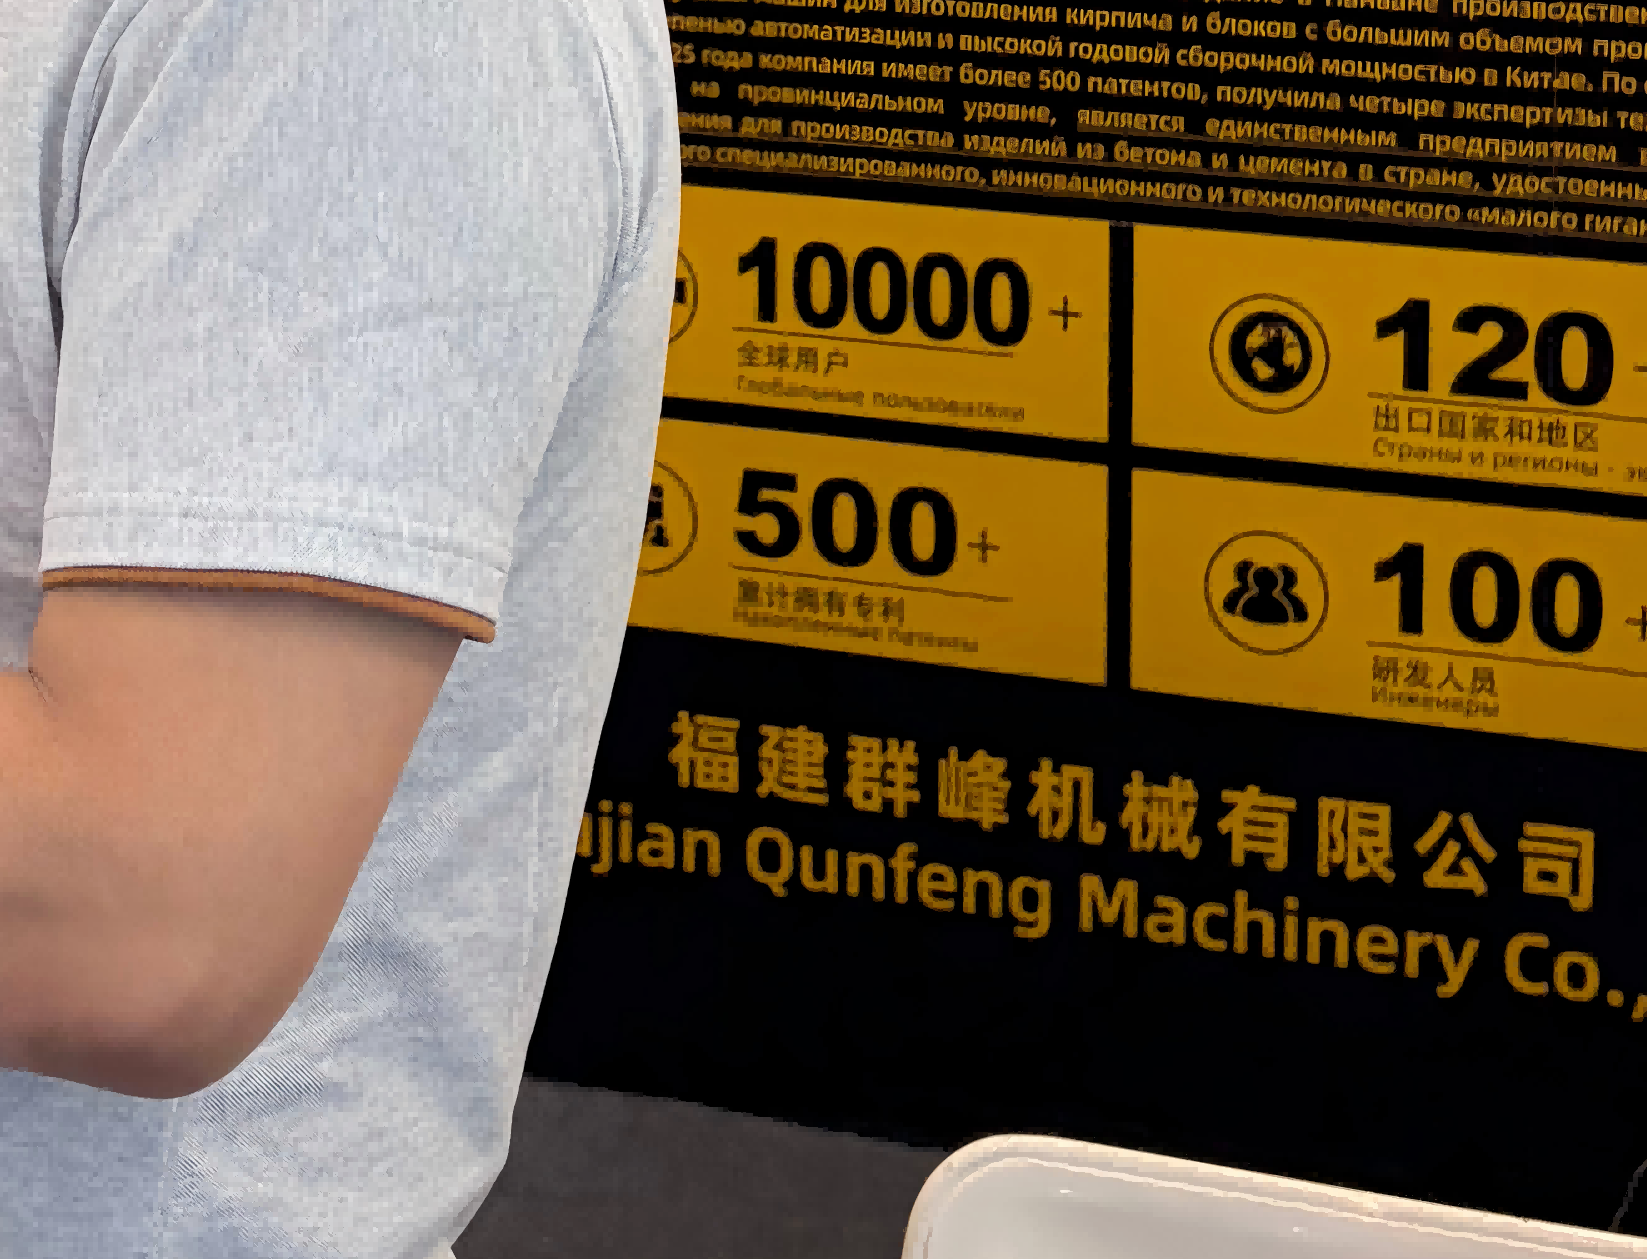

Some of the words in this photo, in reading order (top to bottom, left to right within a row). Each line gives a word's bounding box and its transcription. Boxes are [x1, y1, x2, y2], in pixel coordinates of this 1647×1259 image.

[751, 21, 931, 48] автоматизации
[938, 33, 953, 49] и
[960, 35, 1062, 57] высокой
[1070, 42, 1169, 64] годовой
[1177, 46, 1313, 73] сборочной
[1322, 59, 1475, 84] мощностью
[1507, 67, 1593, 91] Китае.
[1603, 72, 1636, 94] По
[1067, 8, 1172, 30] кирпича
[1183, 16, 1197, 32] и
[1207, 12, 1295, 38] блоков
[1306, 25, 1317, 39] с
[1327, 20, 1449, 47] большим
[1460, 29, 1581, 54] объемом
[703, 50, 752, 69] года
[760, 55, 874, 75] компания
[883, 63, 952, 81] имеет
[960, 63, 1030, 87] более
[1040, 70, 1080, 91] 500
[1088, 77, 1206, 103] патентов,
[1217, 86, 1340, 110] получила
[1453, 102, 1607, 127] экспертизы
[739, 85, 943, 113] провинциальном
[964, 101, 1056, 125] уровне,
[1078, 110, 1184, 132] является
[1206, 119, 1396, 146] единственным
[1419, 134, 1616, 162] предприятием
[717, 149, 985, 183] специализированного,
[993, 170, 1201, 201] инновационного
[1208, 187, 1223, 203] и
[1233, 188, 1460, 221] технологического
[741, 117, 782, 137] для
[793, 122, 953, 147] производства
[1078, 143, 1104, 159] из
[1115, 141, 1200, 167] бетона
[1213, 154, 1228, 169] и
[1240, 155, 1346, 178] цемента
[1385, 166, 1479, 189] стране,
[737, 236, 1031, 347] 10000
[1375, 297, 1614, 407] 120
[1373, 402, 1600, 453] 出口国家和地区
[733, 467, 959, 578] 500
[1374, 541, 1604, 654] 100
[669, 710, 1596, 913] 福建群峰机械有限公司
[745, 825, 1052, 938] Qunfeng
[1077, 872, 1482, 1000] Machinery
